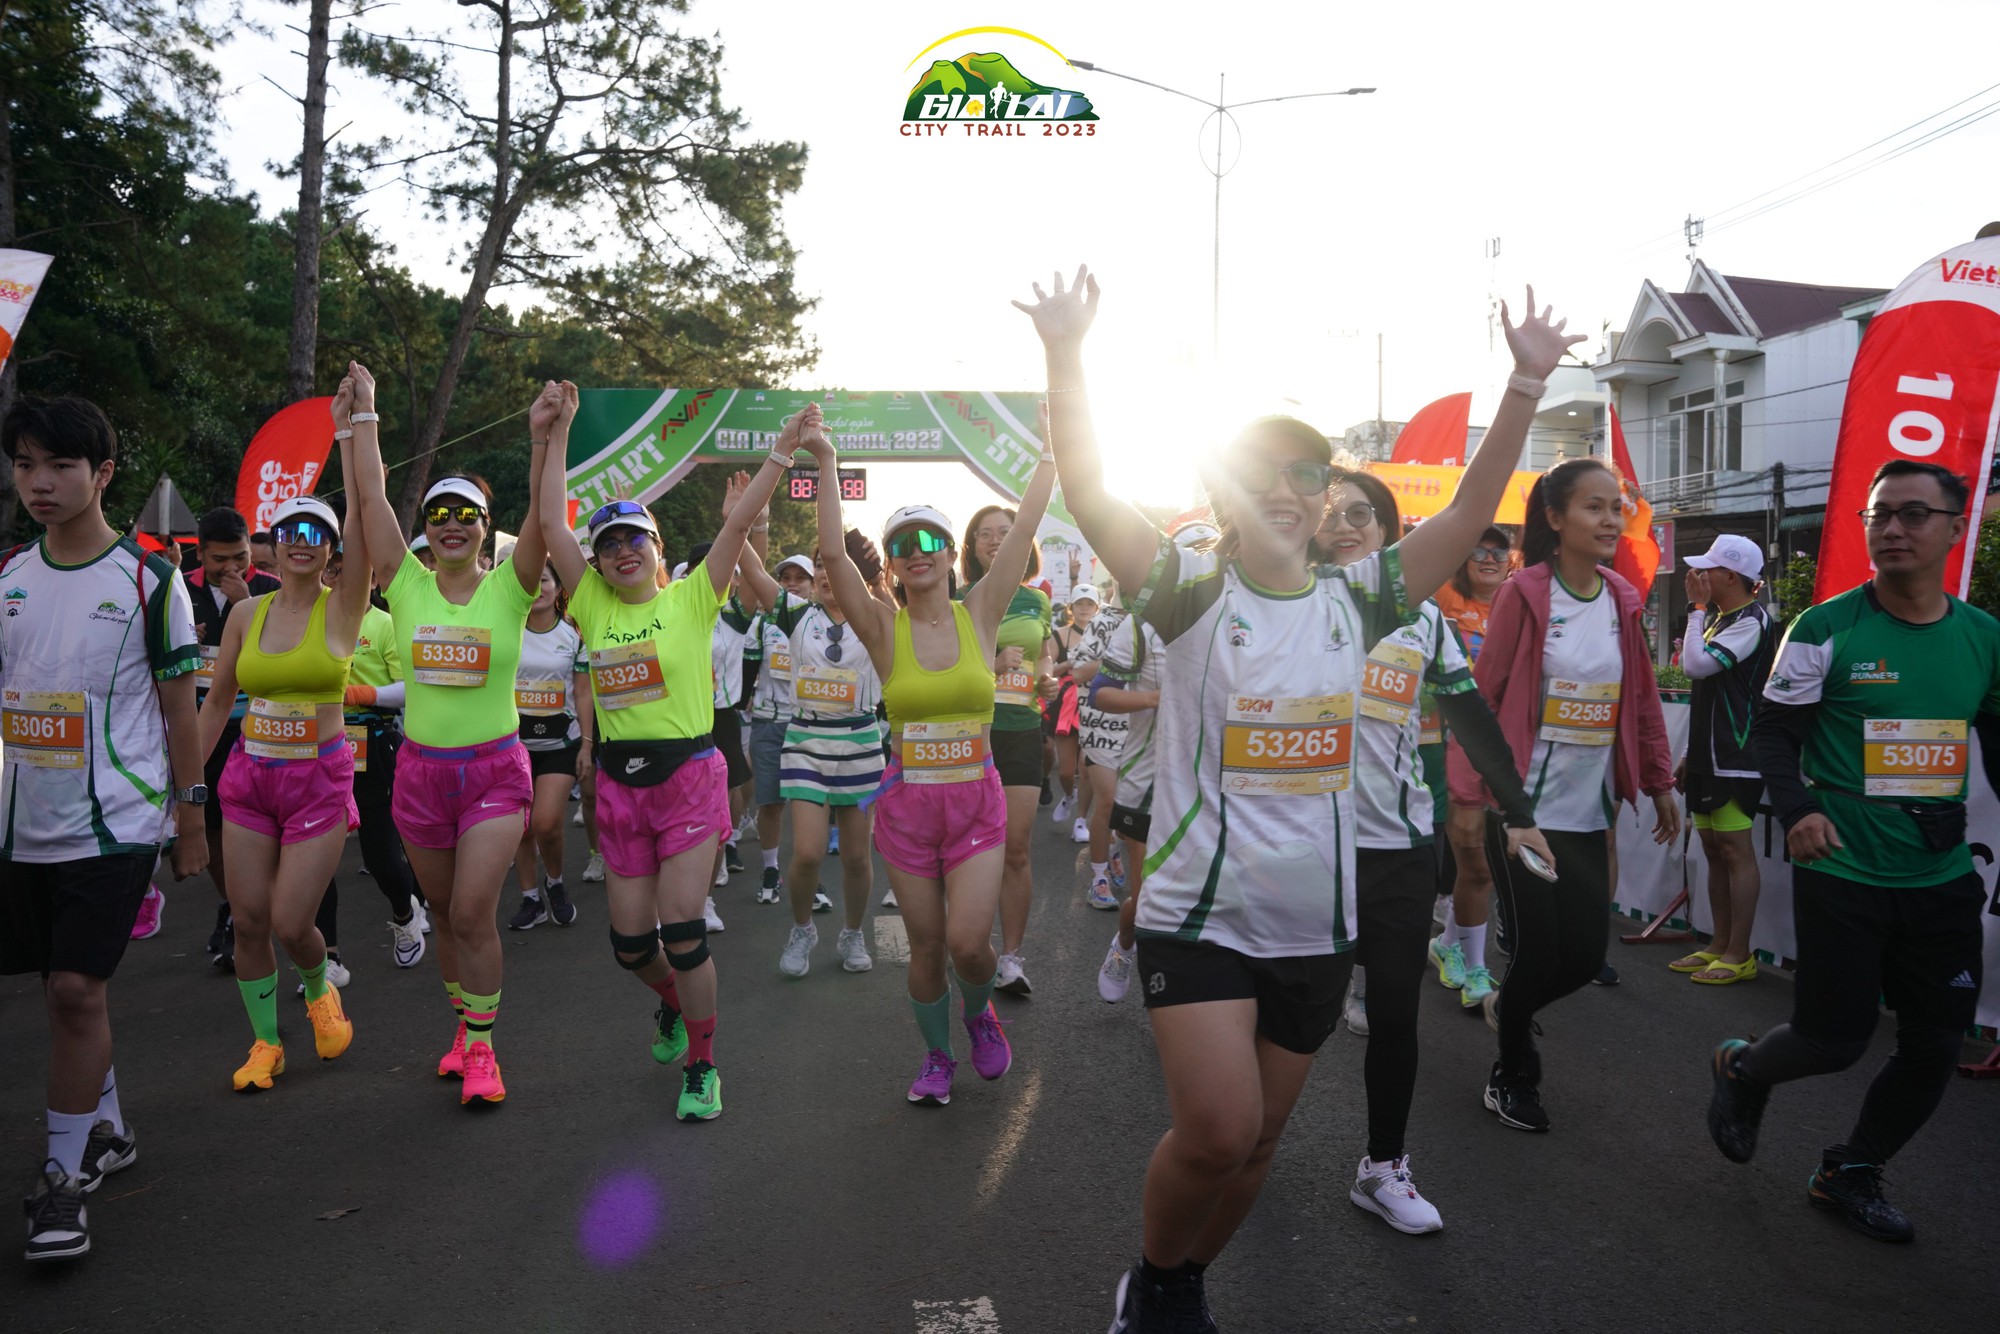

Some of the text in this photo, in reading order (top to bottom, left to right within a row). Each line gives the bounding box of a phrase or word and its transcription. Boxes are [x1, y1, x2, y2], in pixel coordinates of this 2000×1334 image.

[716, 429, 749, 449] GIA
[837, 432, 889, 450] TRAIL
[891, 429, 942, 449] 2023
[567, 433, 666, 517] START
[256, 460, 282, 533] race
[791, 479, 864, 498] 02::58
[422, 644, 479, 664] 53330
[597, 662, 650, 688] 53329
[520, 692, 558, 705] 52818
[804, 681, 849, 698] 53435
[1235, 697, 1274, 713] 5KM
[1557, 701, 1613, 722] 52585
[11, 714, 66, 739] 53061
[254, 717, 307, 738] 53385
[914, 740, 973, 760] 53386
[1246, 728, 1339, 758] 53265
[628, 757, 645, 767] NIKE
[1882, 745, 1957, 767] 53075
